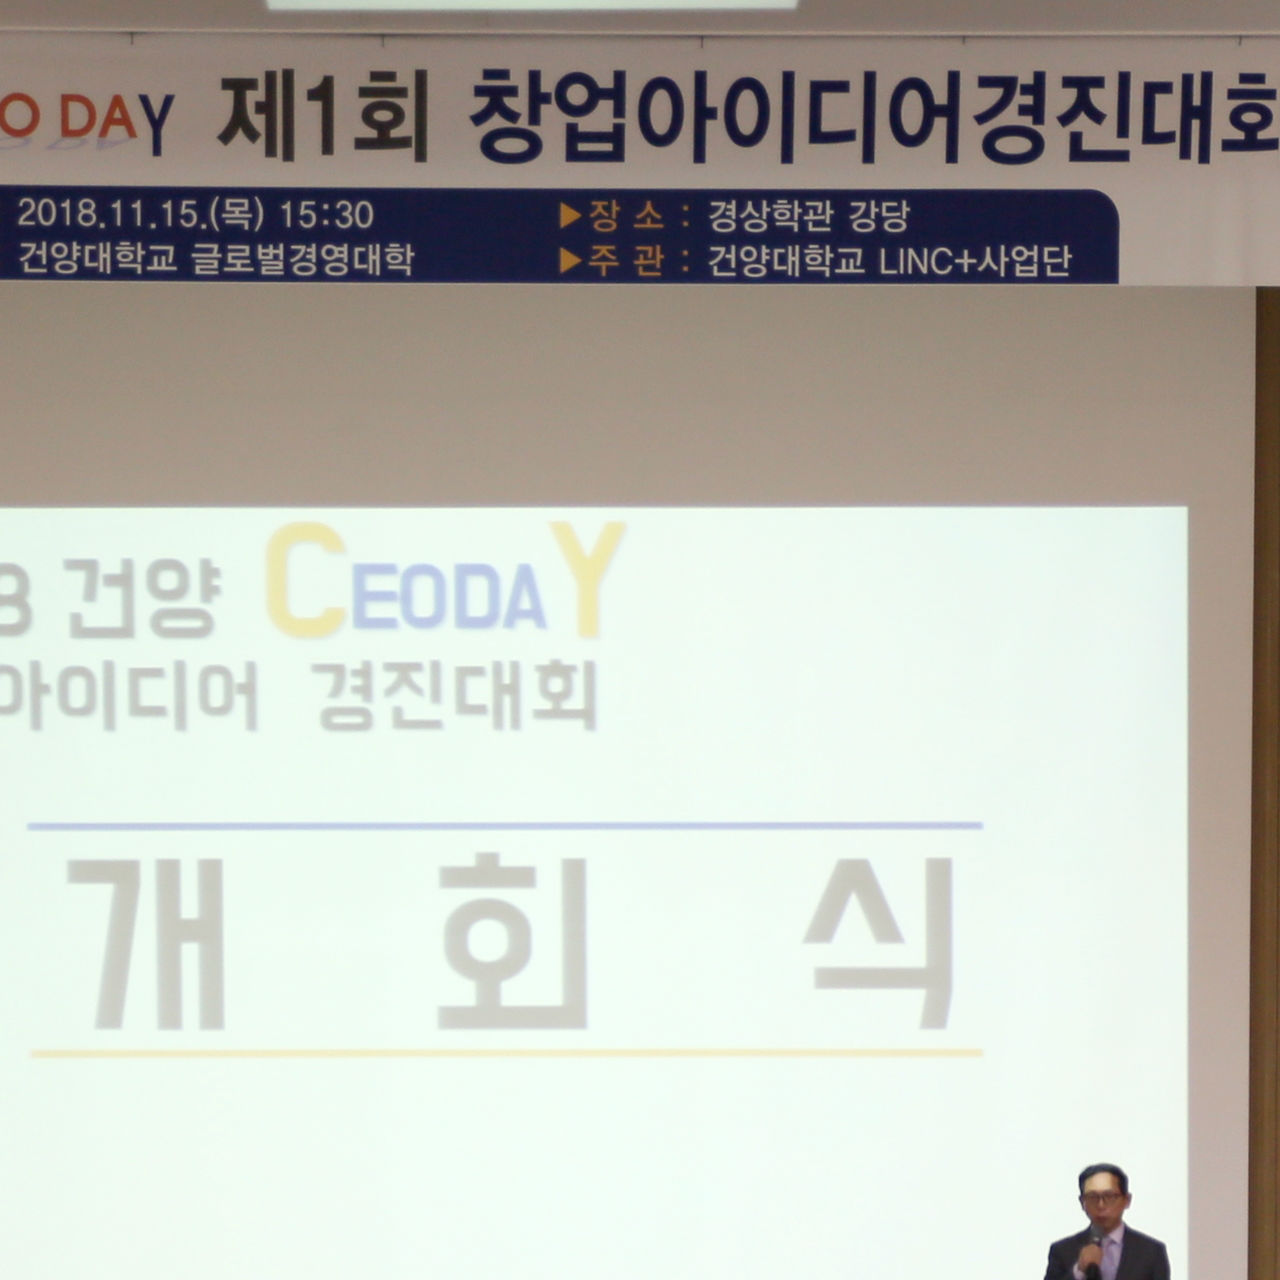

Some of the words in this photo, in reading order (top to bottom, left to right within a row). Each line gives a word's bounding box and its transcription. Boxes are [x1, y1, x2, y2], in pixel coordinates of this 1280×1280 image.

[60, 93, 176, 157] DAY
[217, 67, 429, 163] 제1회
[17, 195, 265, 232] 2018.11.15.(목)
[280, 199, 375, 230] 15:30
[708, 199, 835, 233] 경상학관
[848, 199, 912, 233] 강당
[19, 241, 178, 275] 건양대학교
[191, 242, 416, 277] 글로벌경영대학
[708, 244, 866, 278] 건양대학교
[879, 244, 1074, 278] LINC+사업단
[61, 556, 224, 640] 건양
[264, 520, 627, 639] CEODAY
[310, 658, 598, 732] 경진대회
